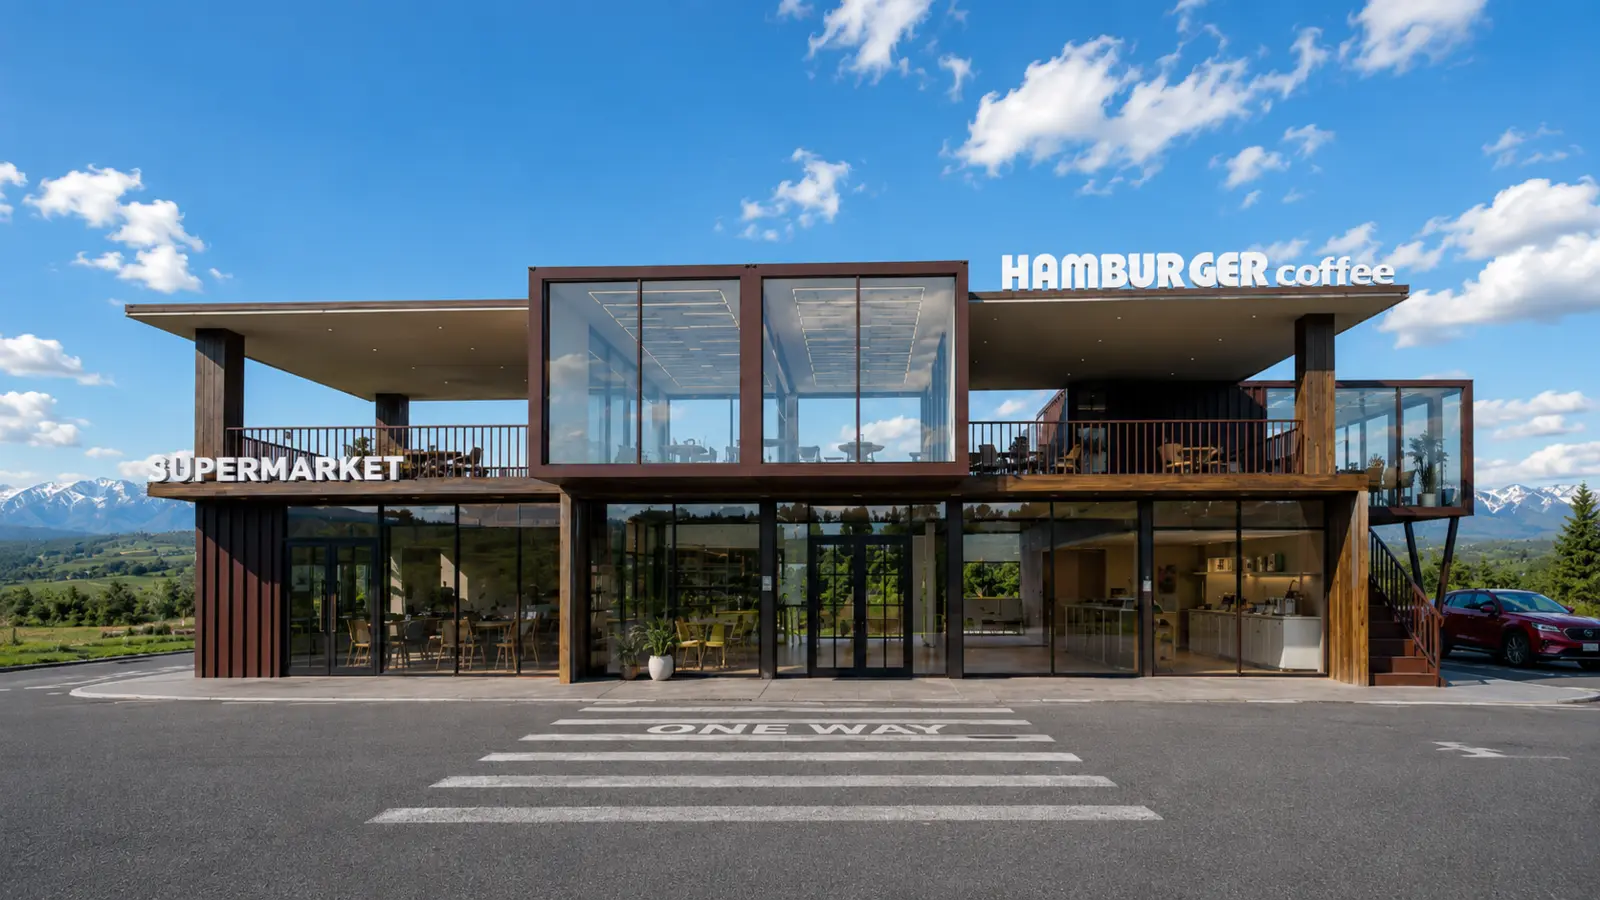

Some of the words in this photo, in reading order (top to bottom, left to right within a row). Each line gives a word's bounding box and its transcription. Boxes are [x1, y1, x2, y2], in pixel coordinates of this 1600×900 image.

[1001, 251, 1268, 291] HAMBURGER
[1275, 256, 1394, 287] coffee
[147, 455, 405, 482] SUPERMARKET
[646, 723, 790, 734] ONE
[808, 723, 947, 734] WAY
